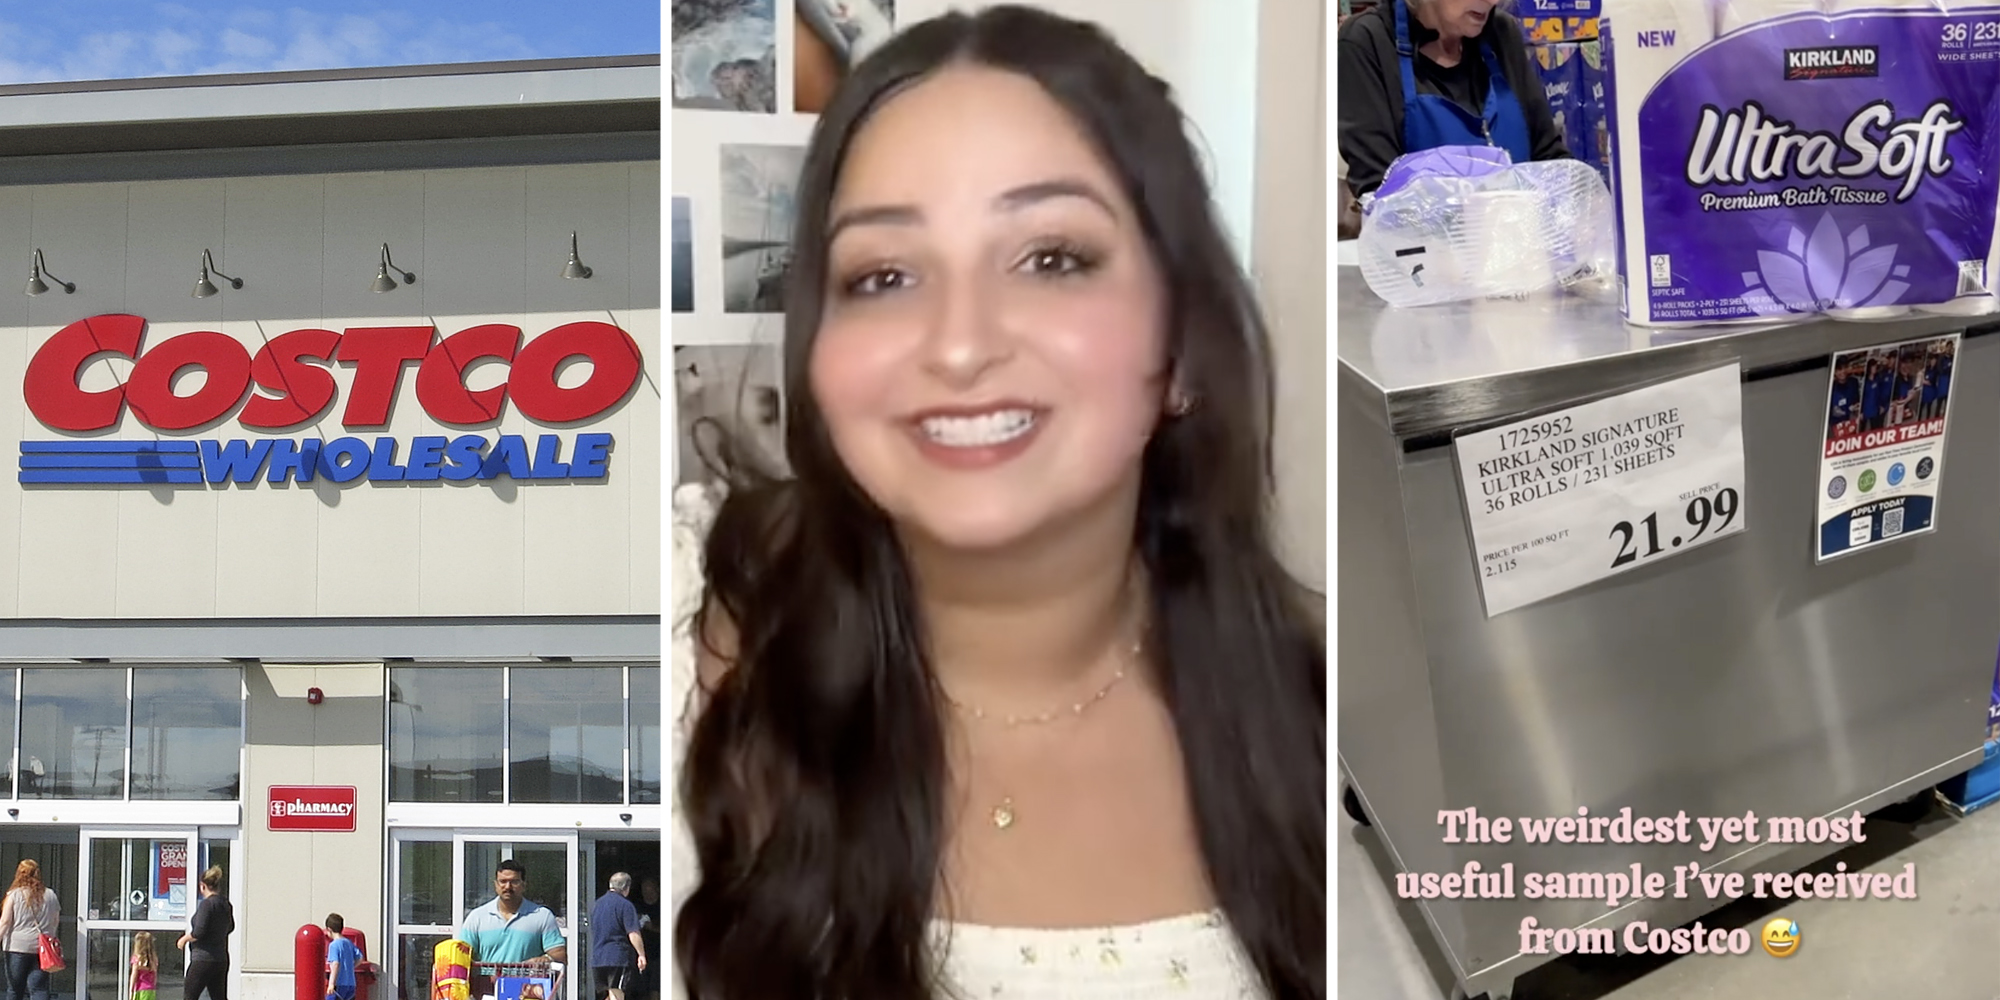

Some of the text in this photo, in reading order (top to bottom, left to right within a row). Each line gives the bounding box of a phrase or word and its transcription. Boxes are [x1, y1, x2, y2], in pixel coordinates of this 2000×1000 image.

[1637, 30, 1676, 48] NEW
[1941, 23, 1967, 42] 36
[1941, 41, 1964, 49] ROLLS
[1789, 49, 1876, 67] KIRKLAND
[1937, 53, 1966, 62] WIDE
[1790, 65, 1875, 80] Signature
[1687, 102, 1963, 201] Ultra Soft
[1700, 186, 1887, 212] Premium Bath Tissue
[1652, 287, 1685, 297] SEPTIC SAFE
[1661, 310, 1679, 318] ROLLS
[1680, 309, 1698, 317] TOTAL
[1678, 300, 1695, 309] PACKS
[1700, 299, 1715, 308] 2-PLY
[23, 313, 641, 431] COSTCO
[1477, 408, 1680, 478] KIRKLAND SIGNATURE
[1499, 416, 1573, 451] 1725952
[1826, 435, 1863, 456] JOIN
[1864, 427, 1897, 448] OUR
[1899, 418, 1943, 440] TEAM!
[199, 432, 614, 484] WHOLESALE
[1482, 424, 1685, 496] ULTRA SOFT 1,039 SQFT
[1485, 444, 1676, 515] 36 ROLLS / 231 SHEETS
[1679, 482, 1721, 502] SELL PRICE
[1851, 502, 1878, 518] APPLY
[1879, 497, 1906, 511] TODAY
[1608, 487, 1739, 569] 21.99
[1483, 529, 1570, 562] PRICE PER 100 SQ FT
[1485, 558, 1517, 578] 2.115
[161, 844, 187, 852] COST
